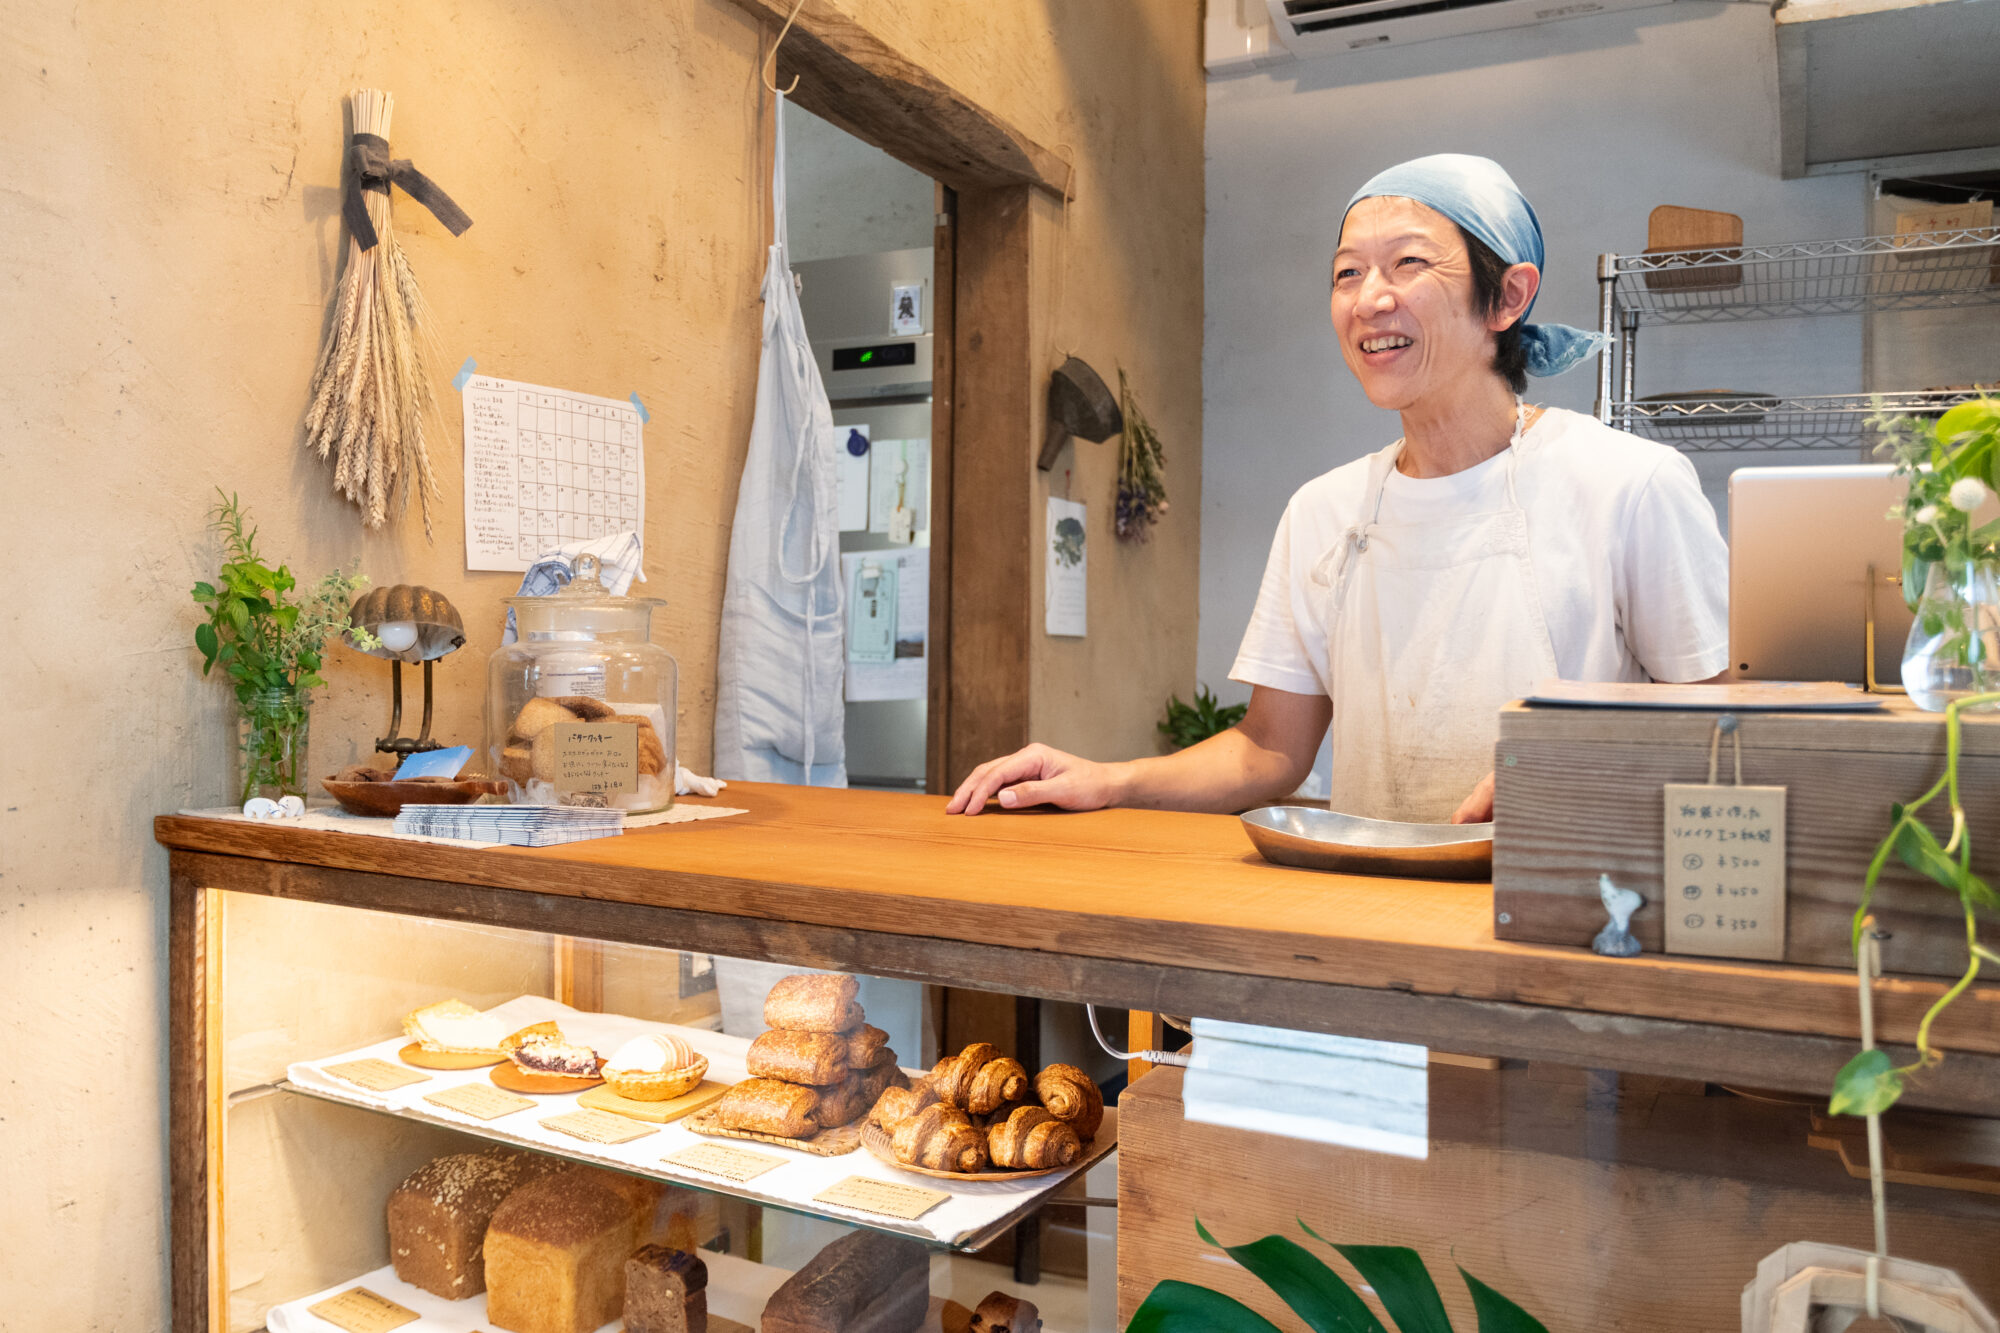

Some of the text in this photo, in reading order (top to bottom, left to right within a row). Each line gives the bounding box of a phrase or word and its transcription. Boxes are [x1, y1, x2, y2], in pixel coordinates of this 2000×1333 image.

[568, 733, 613, 743] バタークッキー
